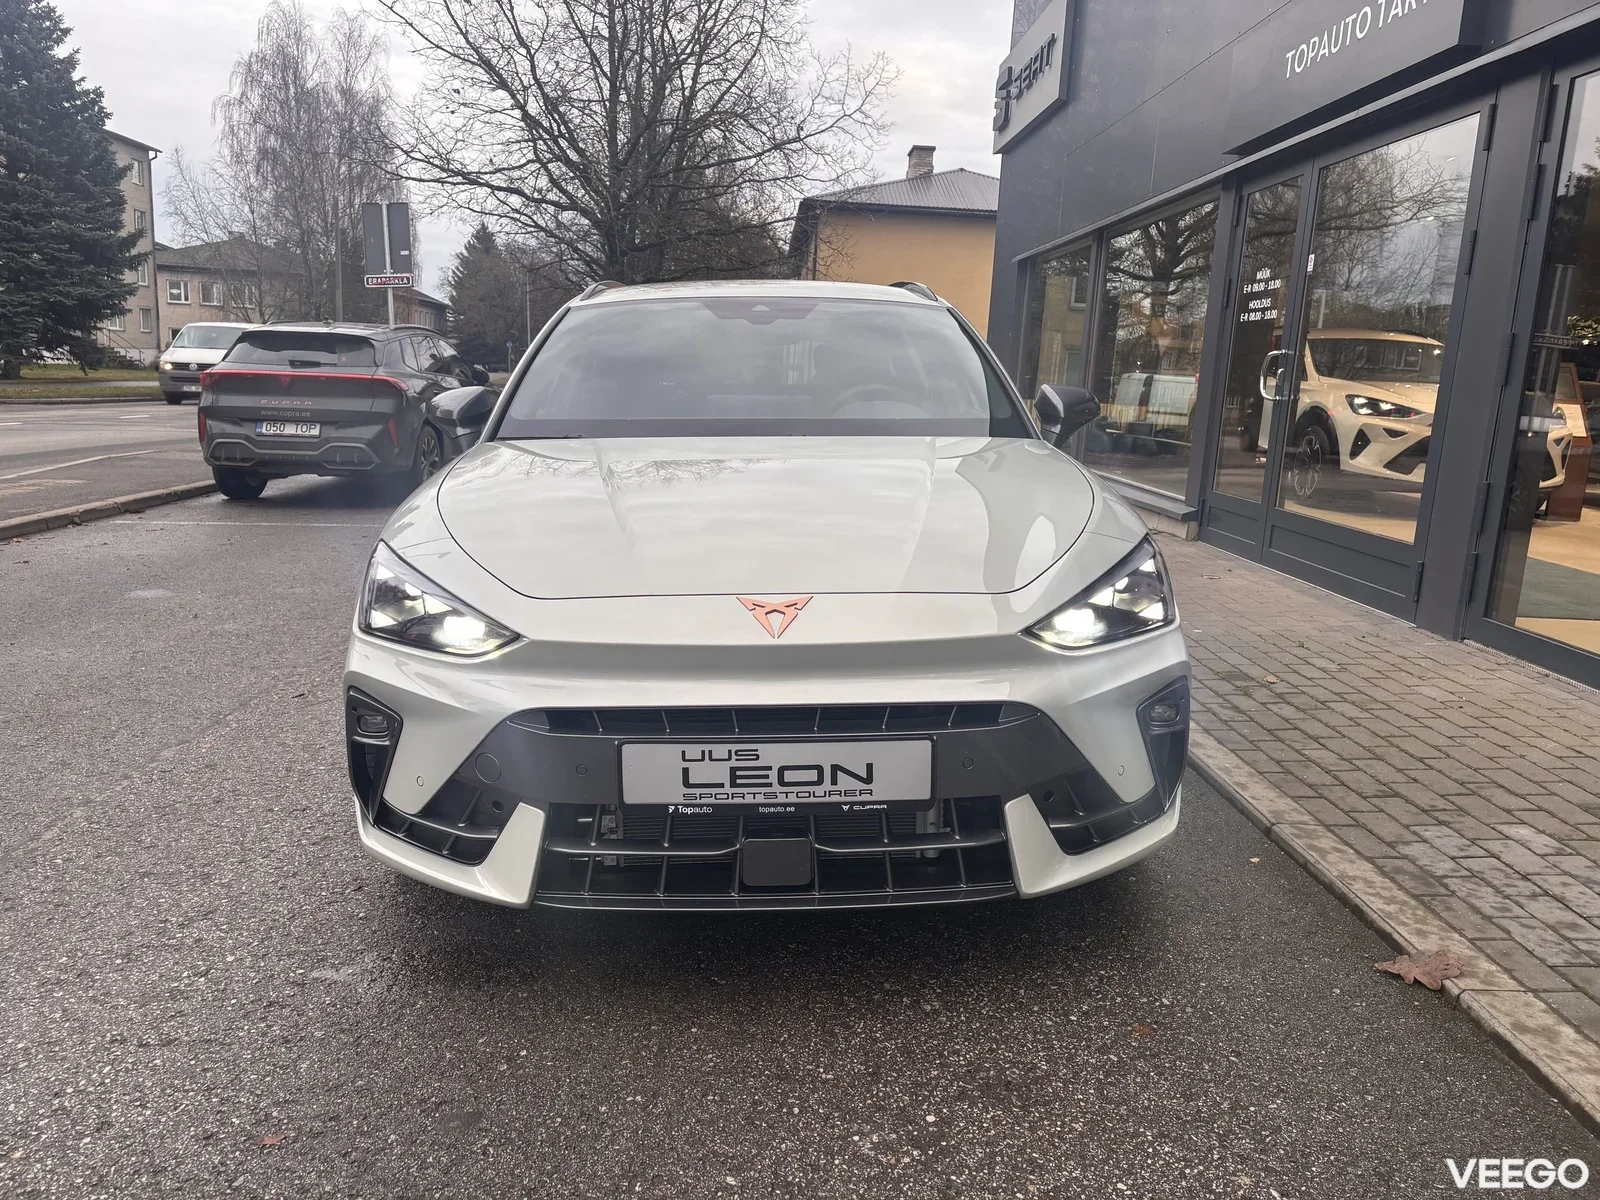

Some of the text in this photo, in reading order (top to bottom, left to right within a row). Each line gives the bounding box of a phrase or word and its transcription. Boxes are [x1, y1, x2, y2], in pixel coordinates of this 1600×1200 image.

[1286, 6, 1372, 79] TOPAUTO
[1256, 268, 1271, 280] MÜÜK
[1243, 284, 1251, 294] E-R
[1248, 298, 1271, 309] HOOLDUS
[1240, 313, 1248, 322] E-R
[265, 422, 286, 432] 050
[294, 423, 317, 433] TOP
[681, 749, 760, 762] UUS
[682, 763, 873, 789] LEON
[683, 789, 873, 801] SPORTSTOURER
[677, 806, 712, 814] Topauto
